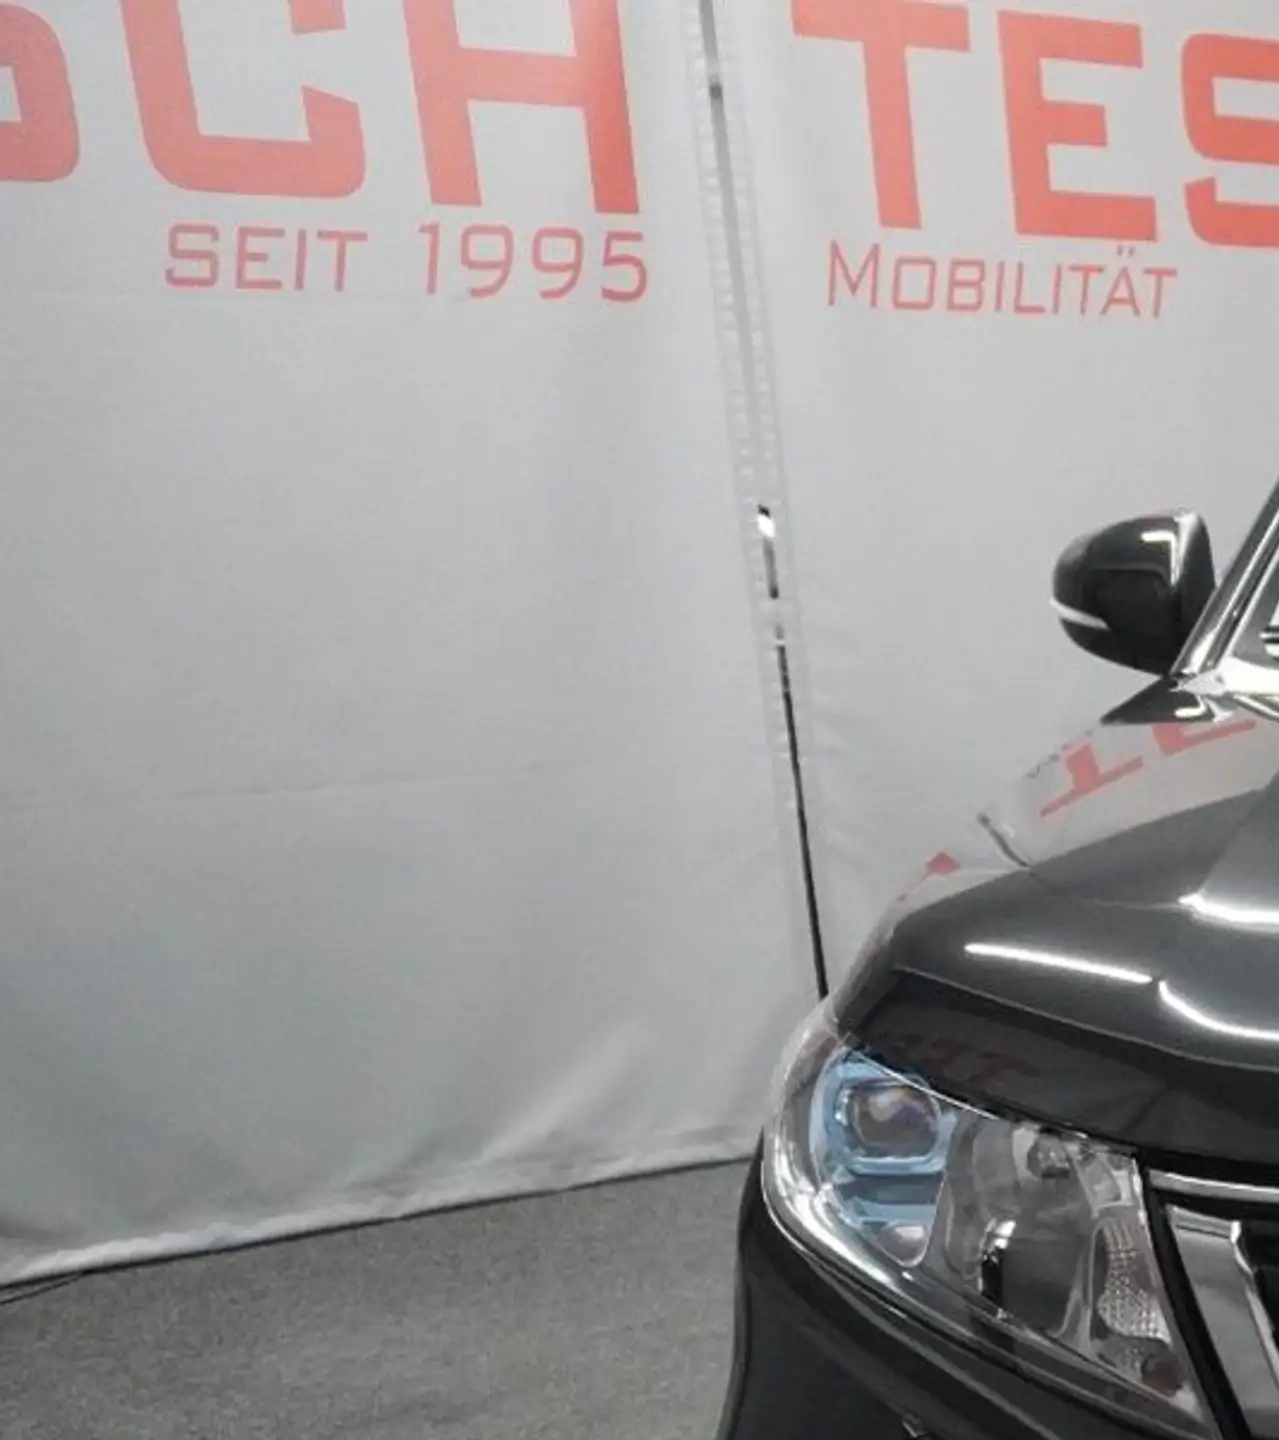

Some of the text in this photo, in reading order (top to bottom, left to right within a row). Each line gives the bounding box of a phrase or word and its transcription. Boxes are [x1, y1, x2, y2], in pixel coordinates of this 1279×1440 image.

[164, 222, 648, 304] SEIT 1995
[827, 241, 1178, 319] MOBILITÄT
